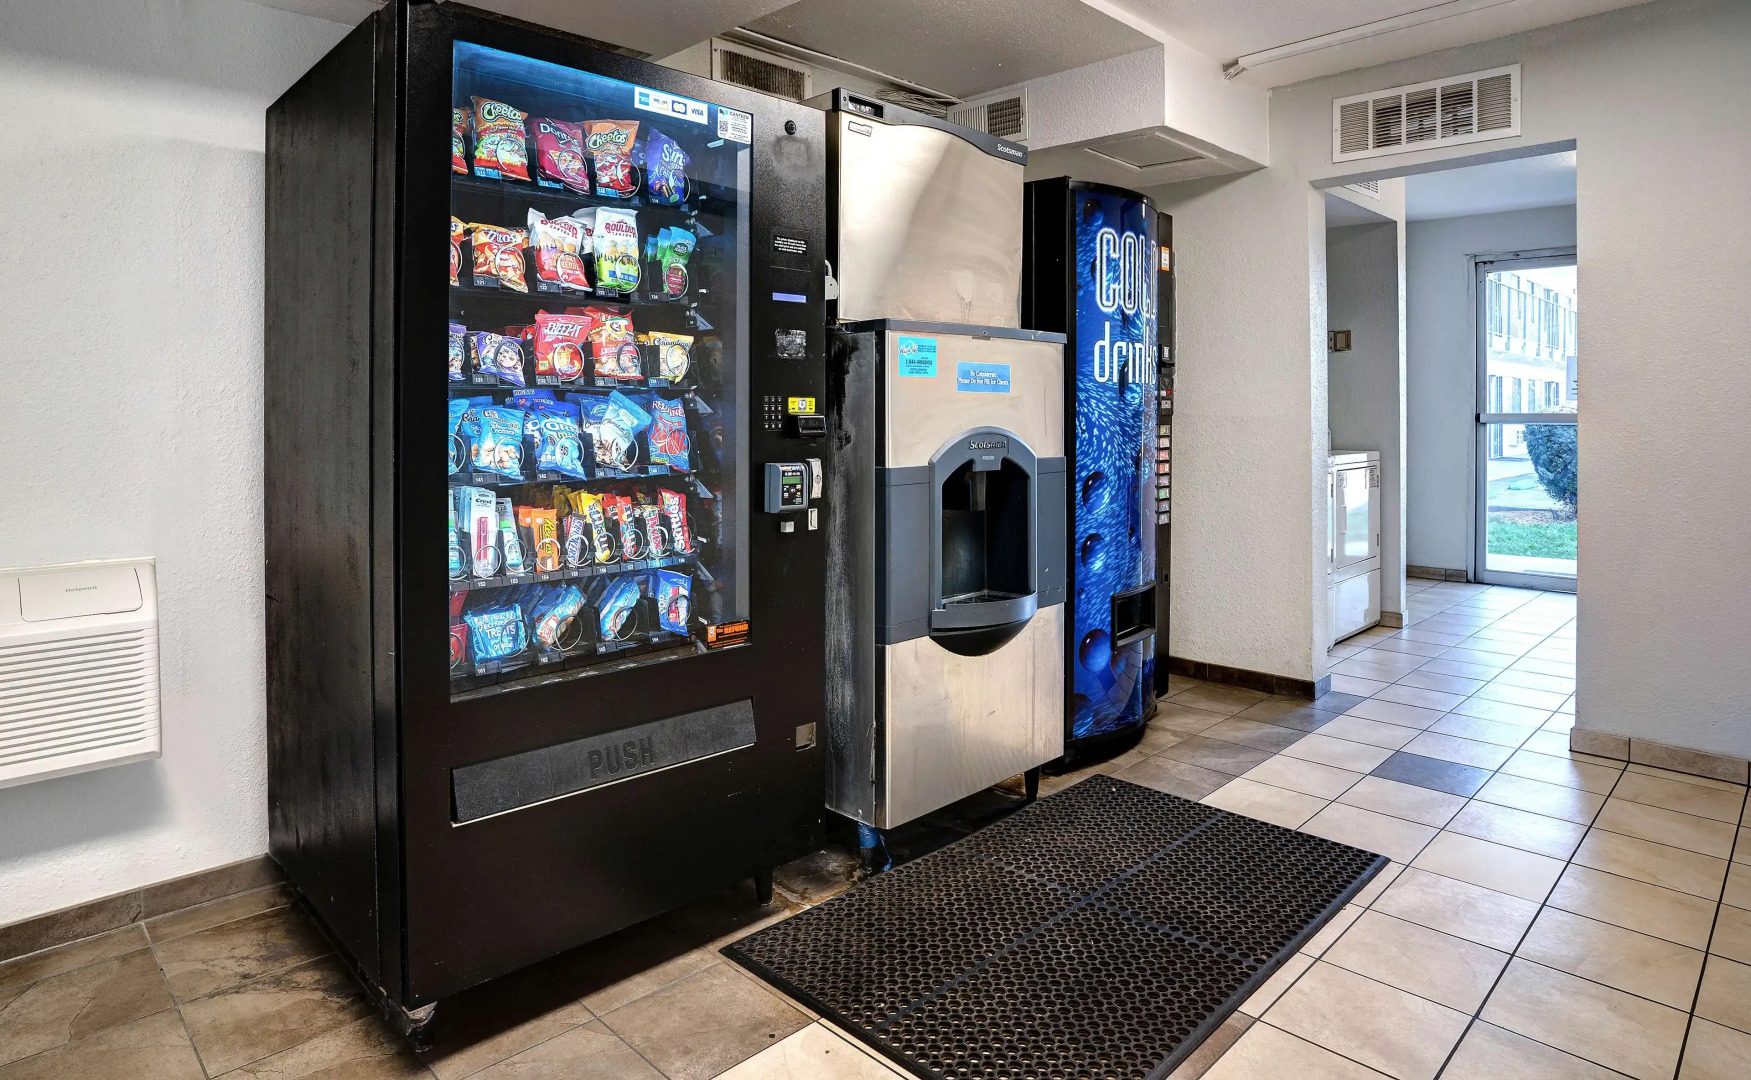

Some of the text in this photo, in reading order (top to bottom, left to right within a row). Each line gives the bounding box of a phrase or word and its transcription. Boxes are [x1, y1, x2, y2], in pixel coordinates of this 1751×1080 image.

[482, 102, 522, 120] Cheetos
[691, 108, 704, 116] VISA
[588, 129, 629, 149] Cheetos
[997, 143, 1023, 158] Scotsman
[605, 222, 637, 238] BOULDER
[1094, 321, 1157, 383] drinks
[969, 440, 1007, 450] Scotsman
[587, 737, 655, 780] PUSH
